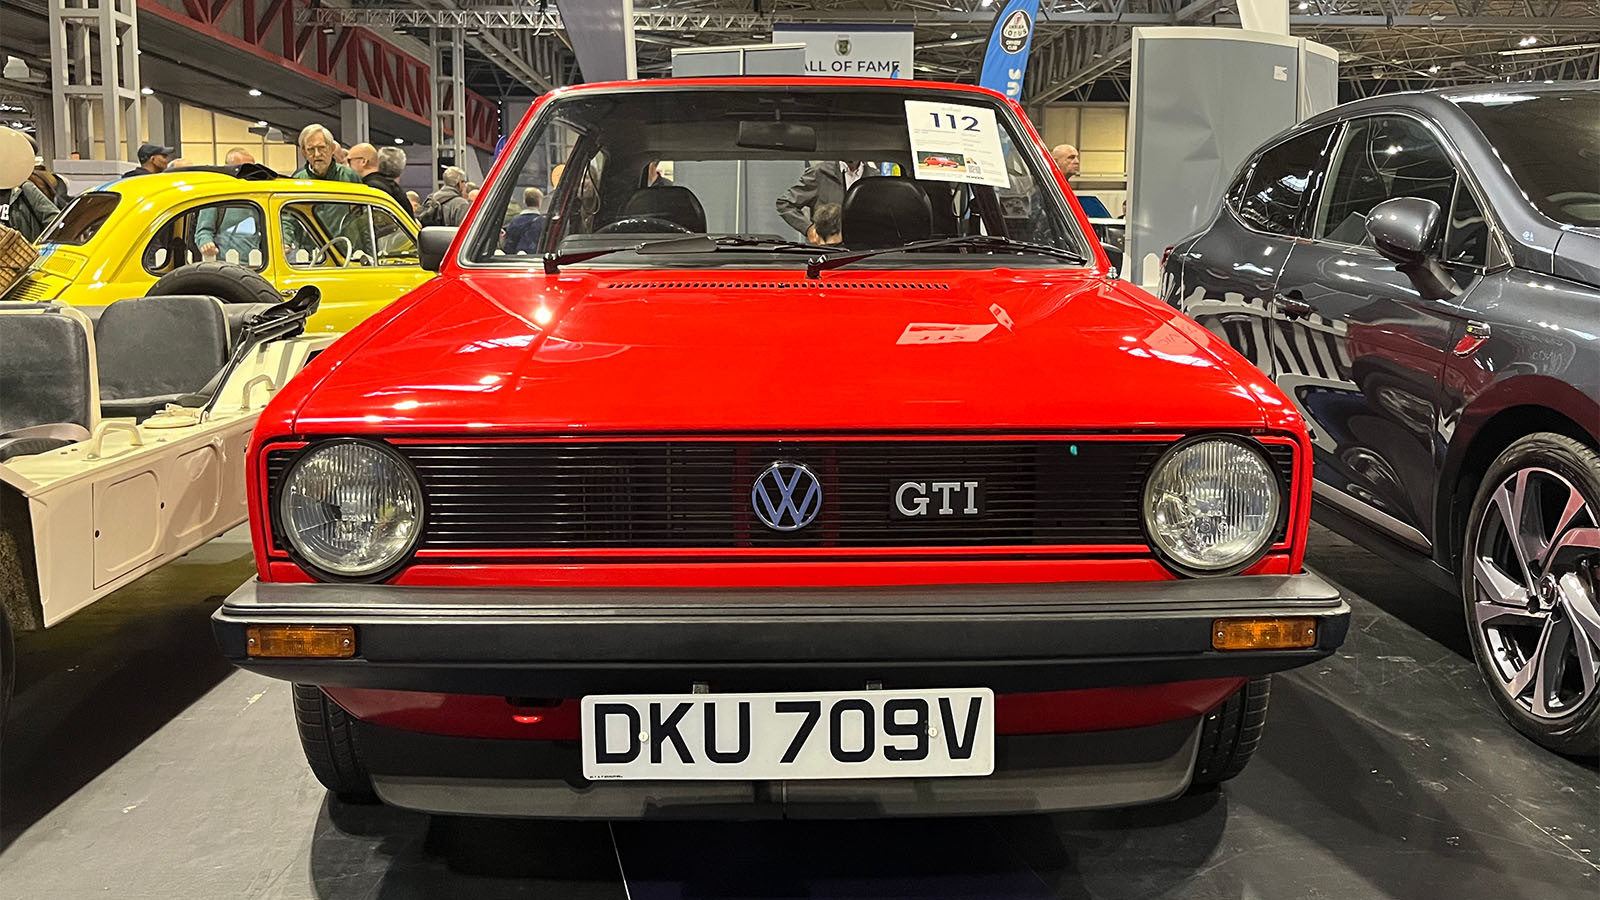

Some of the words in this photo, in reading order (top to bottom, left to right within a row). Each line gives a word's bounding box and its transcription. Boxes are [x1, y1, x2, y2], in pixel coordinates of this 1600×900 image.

[805, 61, 827, 72] LL
[831, 61, 853, 72] OF
[929, 112, 981, 133] 112
[895, 481, 979, 517] GTI
[593, 701, 751, 765] DKU
[774, 696, 983, 764] 709V
